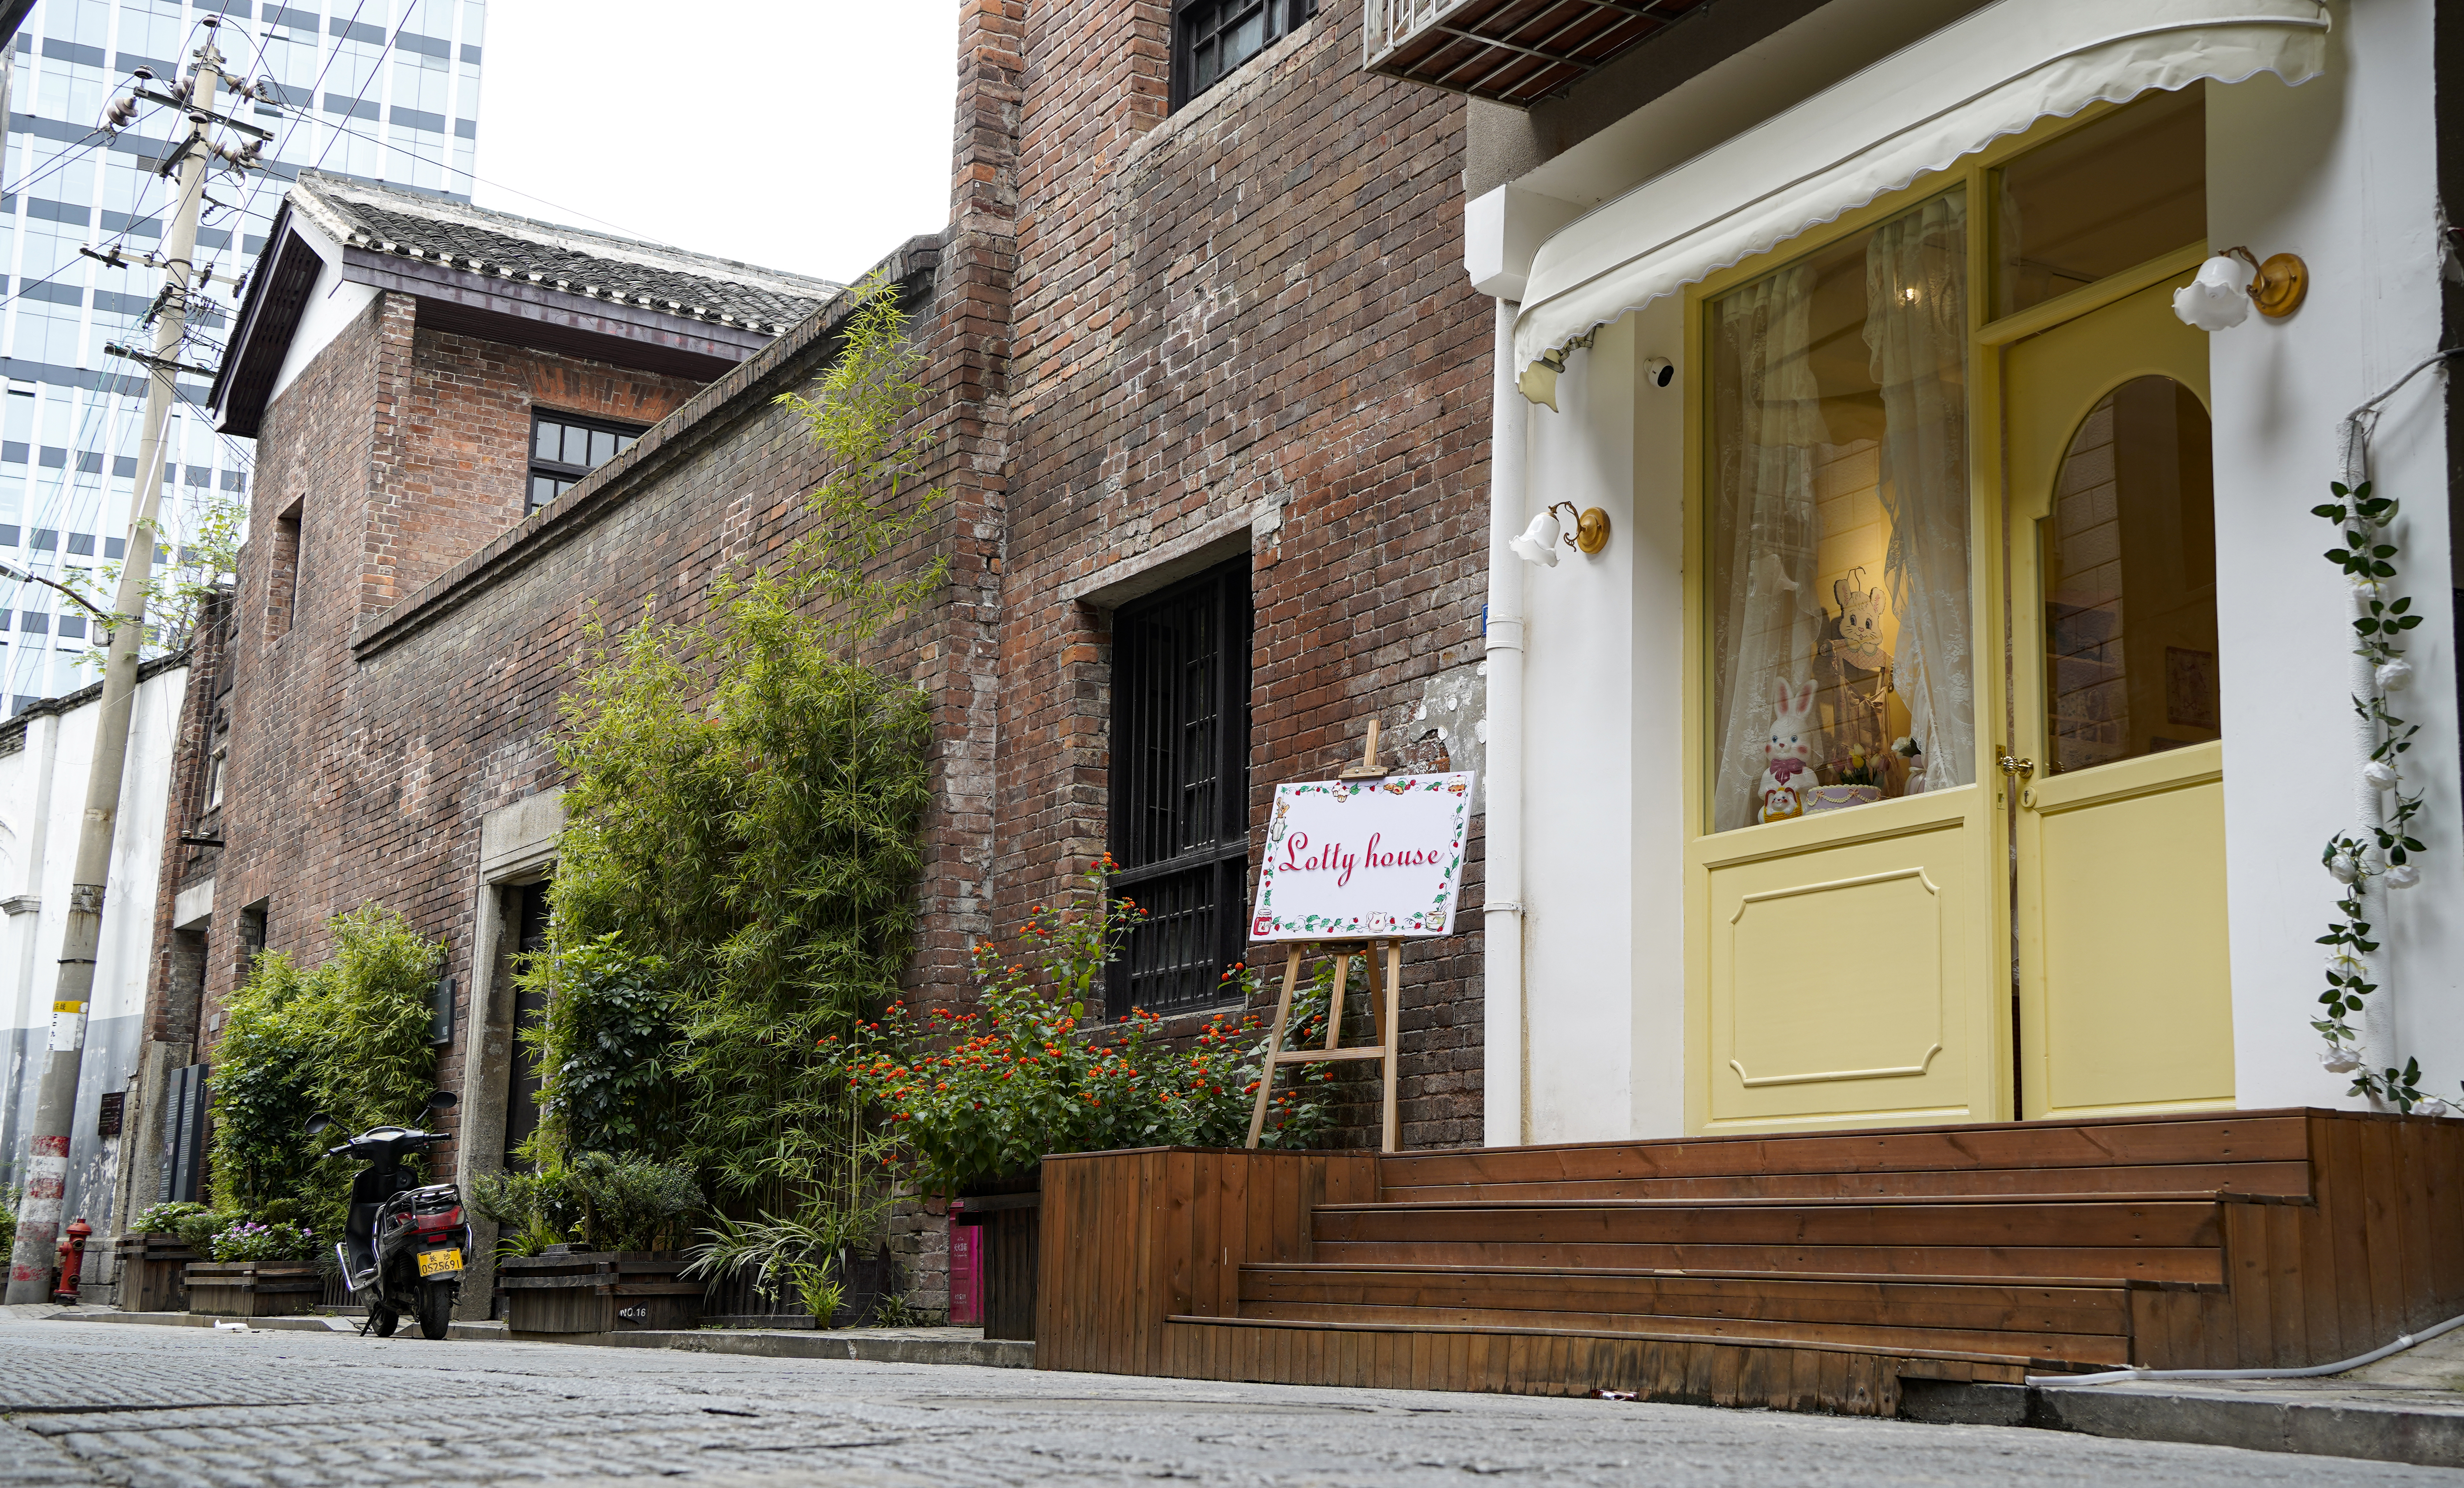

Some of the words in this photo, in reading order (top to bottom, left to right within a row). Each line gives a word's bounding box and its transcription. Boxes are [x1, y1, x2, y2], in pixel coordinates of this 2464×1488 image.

[1279, 832, 1361, 887] Lotty
[1365, 833, 1444, 869] house
[429, 1253, 451, 1262] 长沙
[422, 1259, 460, 1274] 0525691
[620, 1308, 646, 1317] NO.16
